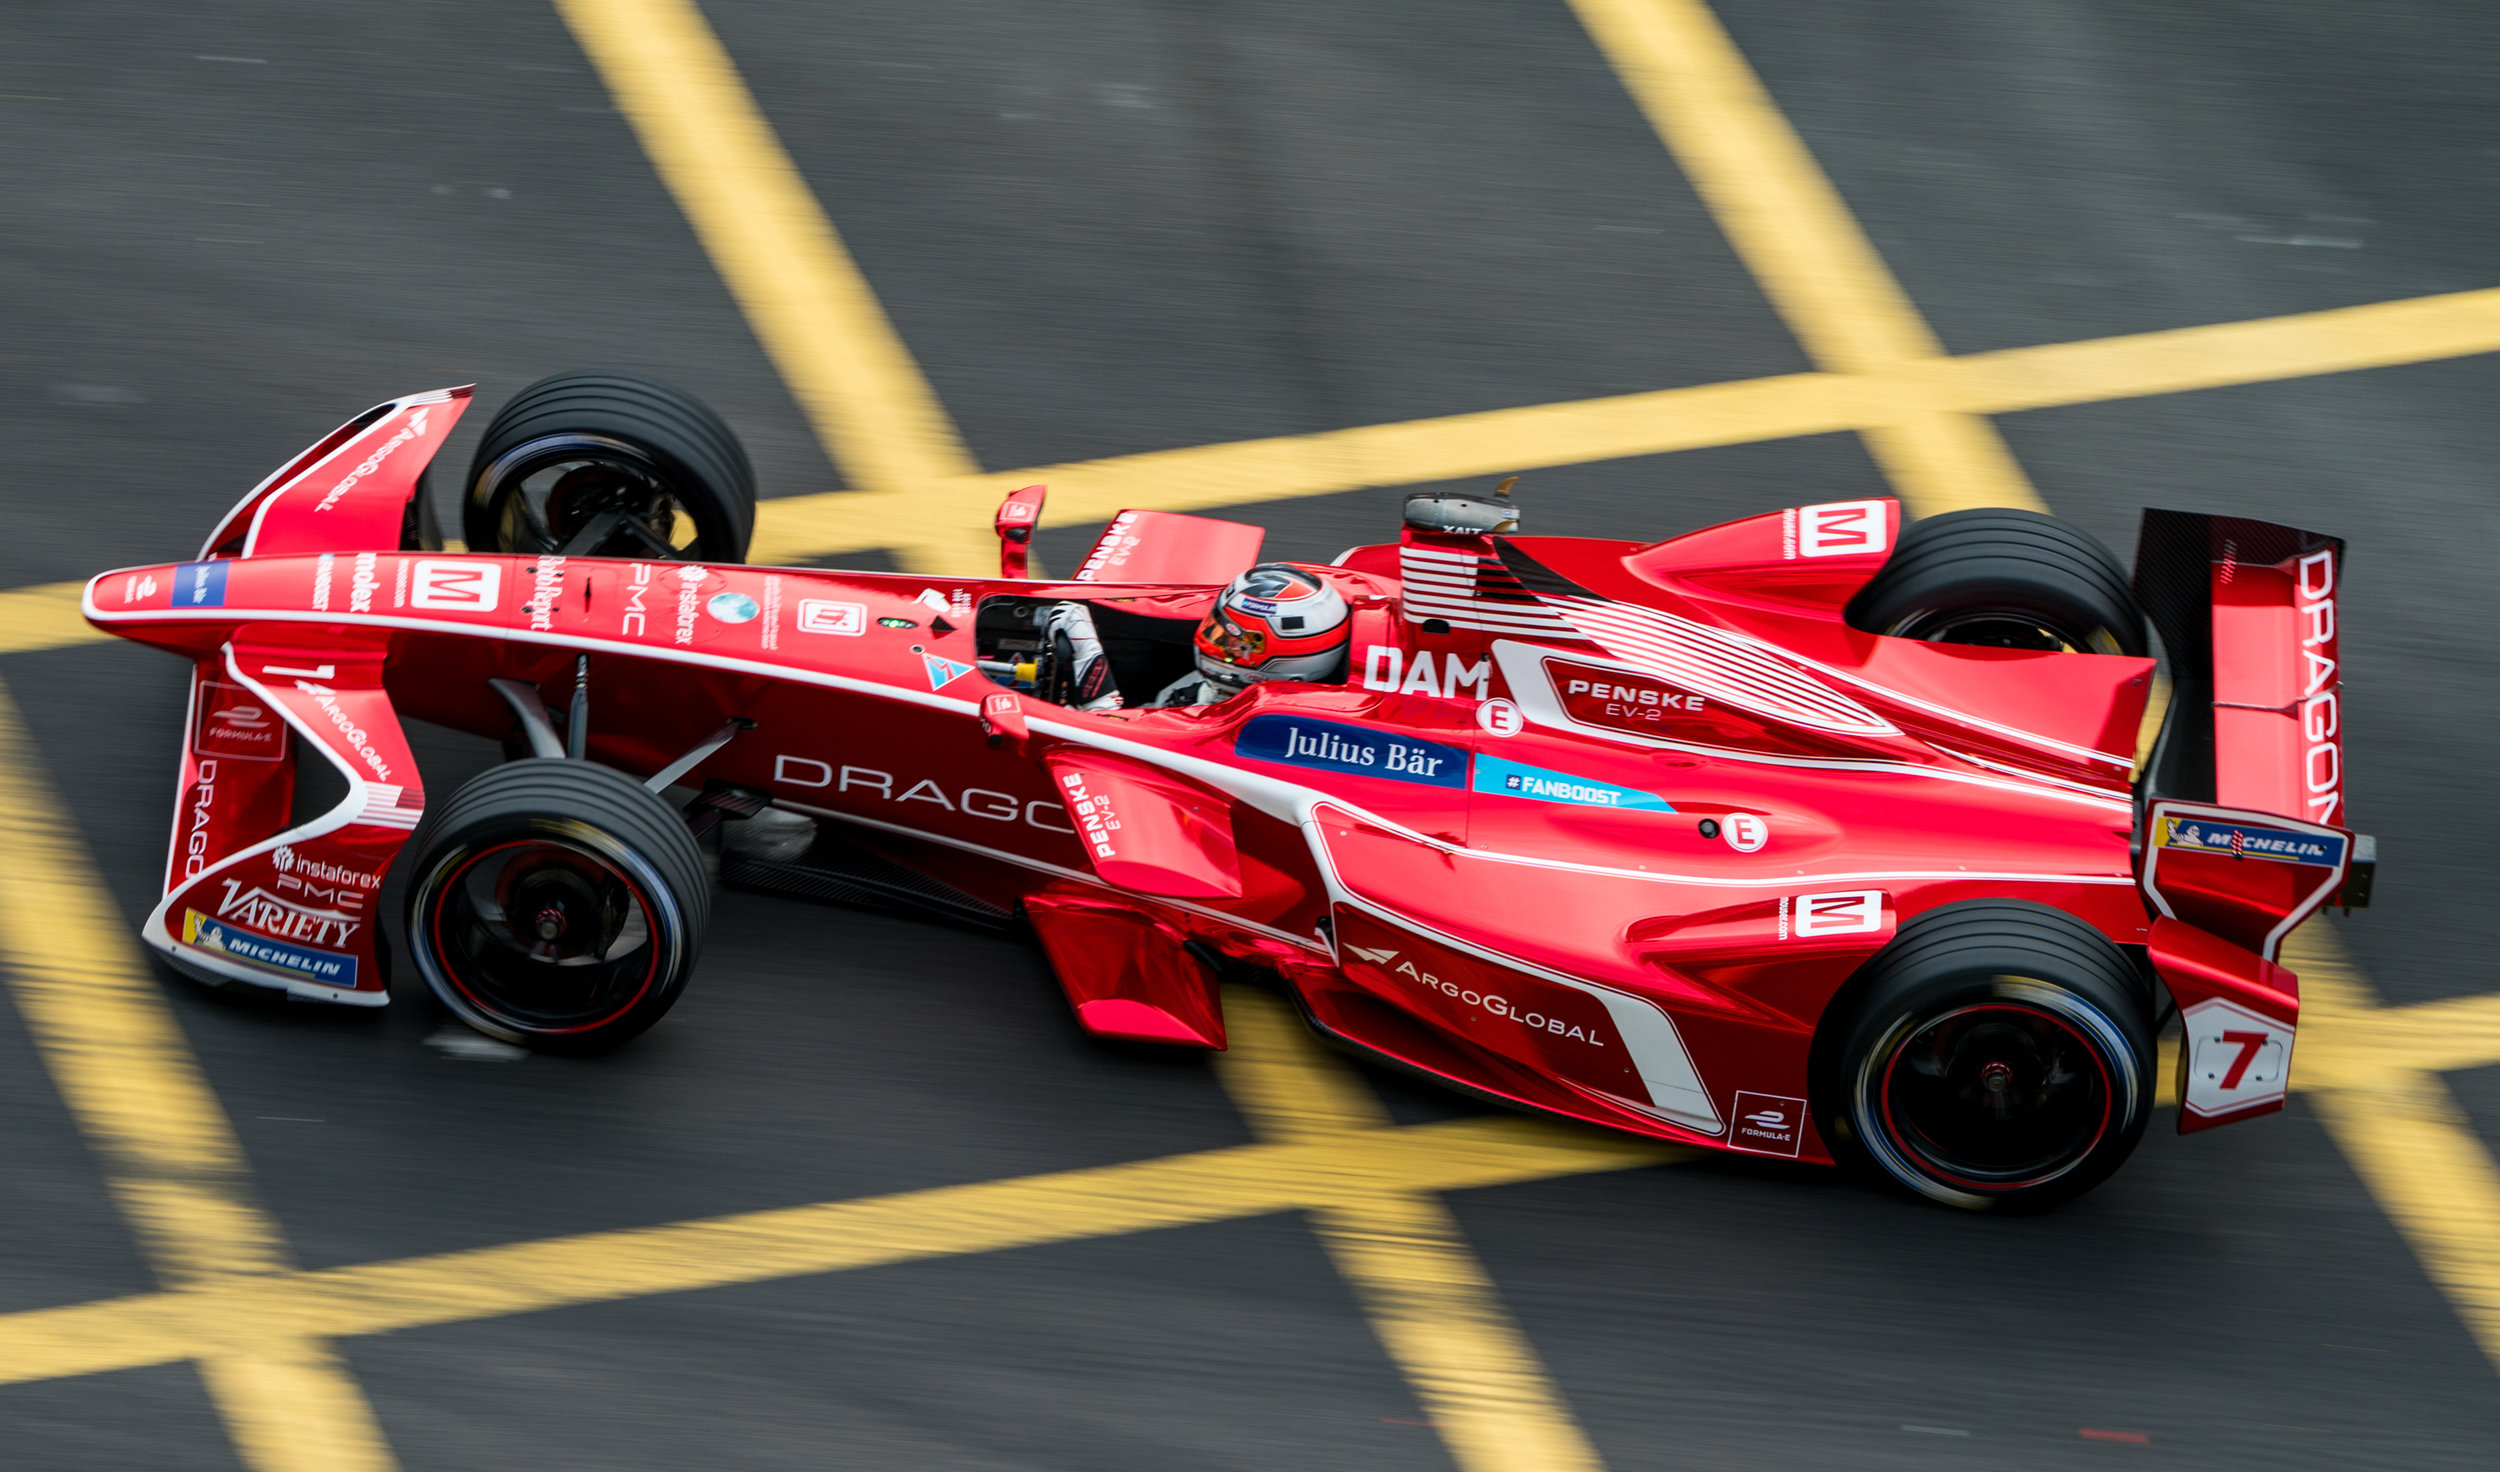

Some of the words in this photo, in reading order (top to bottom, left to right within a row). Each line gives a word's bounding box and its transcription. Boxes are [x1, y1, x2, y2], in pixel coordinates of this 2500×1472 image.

[1076, 512, 1139, 580] PENSKE
[1817, 508, 1867, 547] M
[350, 553, 380, 612] molex
[427, 568, 483, 603] M
[621, 563, 650, 637] PMC
[675, 581, 703, 645] instaforex
[1363, 644, 1489, 701] DAM
[1568, 679, 1706, 711] PENSKE
[1605, 703, 1663, 722] EV-2
[1284, 727, 1376, 767] Julius
[1385, 743, 1444, 778] Bär
[1506, 774, 1622, 806] #FANBOOST
[1062, 773, 1116, 858] PENSKE
[1093, 795, 1122, 831] EV-2
[2207, 832, 2327, 857] MCHELIN
[296, 854, 381, 889] instaforex
[277, 874, 364, 909] PMC
[217, 878, 361, 948] VARIETY
[1779, 897, 1789, 941] mouser.com
[1810, 896, 1865, 929] M
[229, 938, 341, 976] MICHELIN
[2219, 1030, 2270, 1090] 7
